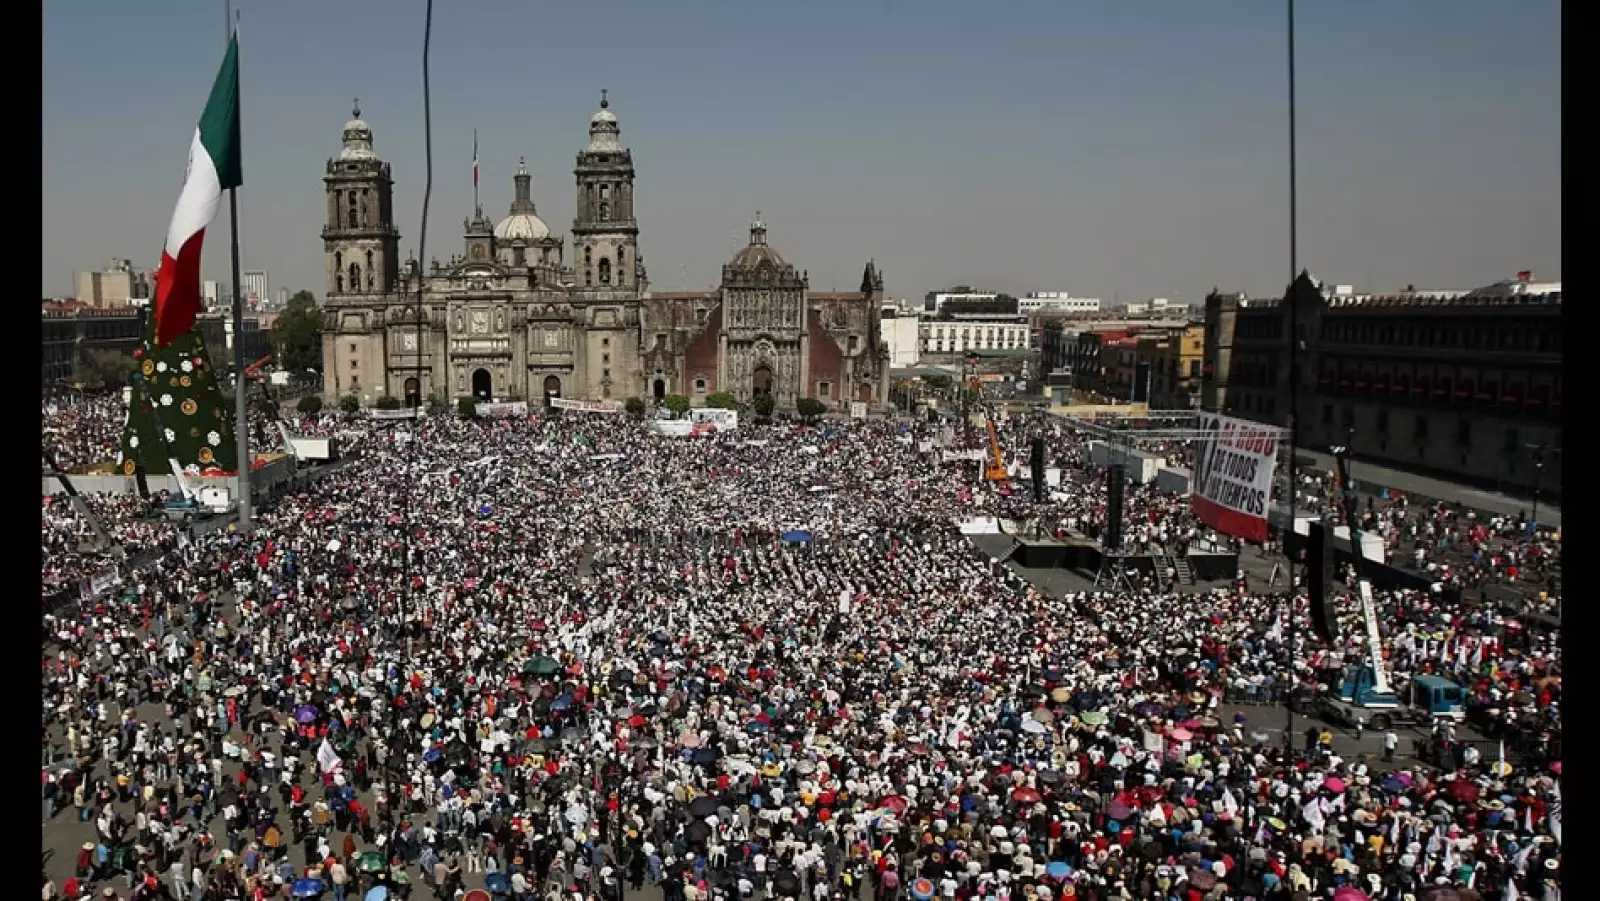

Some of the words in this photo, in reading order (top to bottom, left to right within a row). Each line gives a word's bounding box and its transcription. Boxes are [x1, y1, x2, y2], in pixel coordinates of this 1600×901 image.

[1236, 425, 1276, 457] ROBO
[1212, 448, 1228, 474] DE
[1224, 451, 1259, 482] TODOS
[1219, 480, 1265, 515] TIEMPOS
